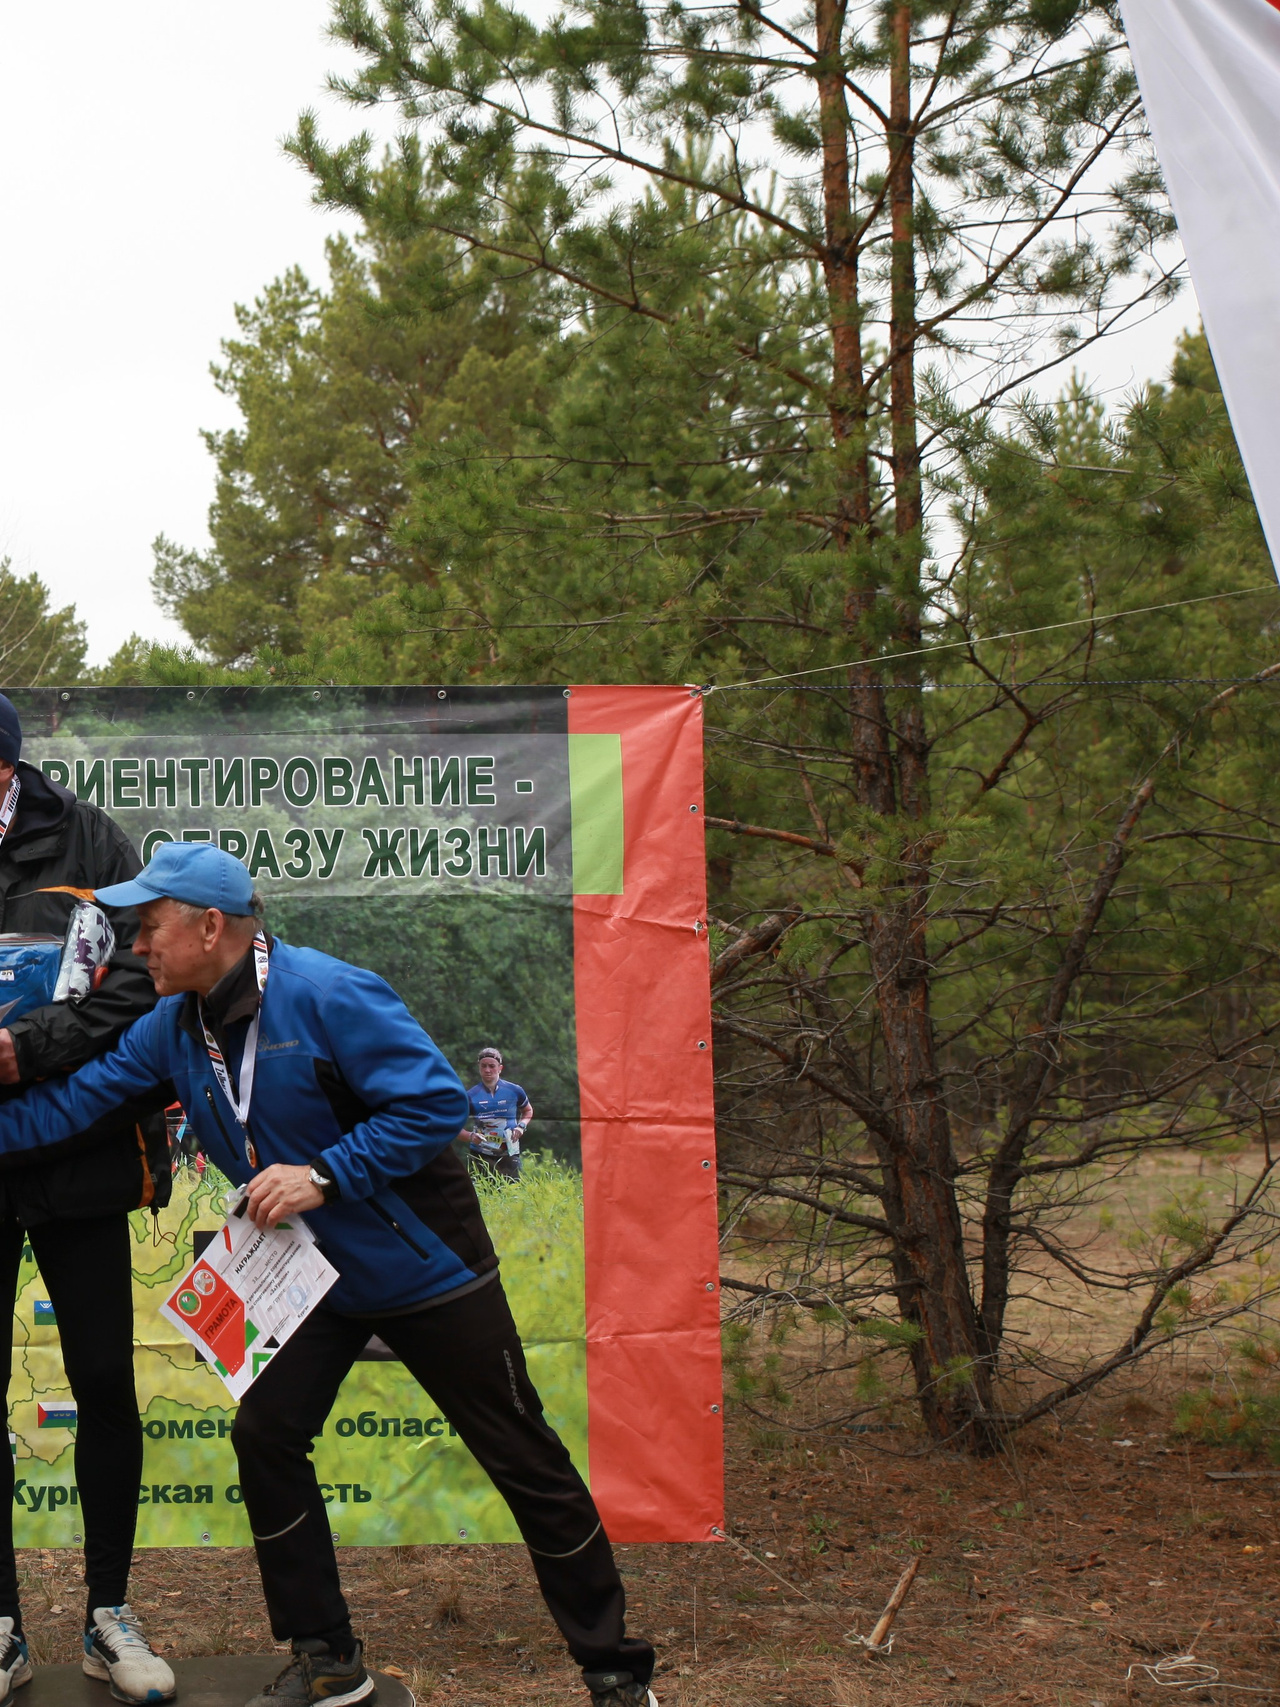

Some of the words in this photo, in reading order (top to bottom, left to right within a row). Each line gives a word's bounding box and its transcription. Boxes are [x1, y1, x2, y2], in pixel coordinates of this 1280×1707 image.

[20, 756, 496, 809] РИЕНТИРОВАНИЕ
[141, 828, 345, 879] ОРАЗУ
[362, 826, 547, 878] ЖИЗНИ
[234, 1232, 267, 1274] НАГРАЖДАЕТ
[204, 1298, 238, 1340] ГРАМОТА
[335, 1410, 458, 1438] област
[13, 1478, 214, 1513] Кургская
[224, 1483, 372, 1504] ость
